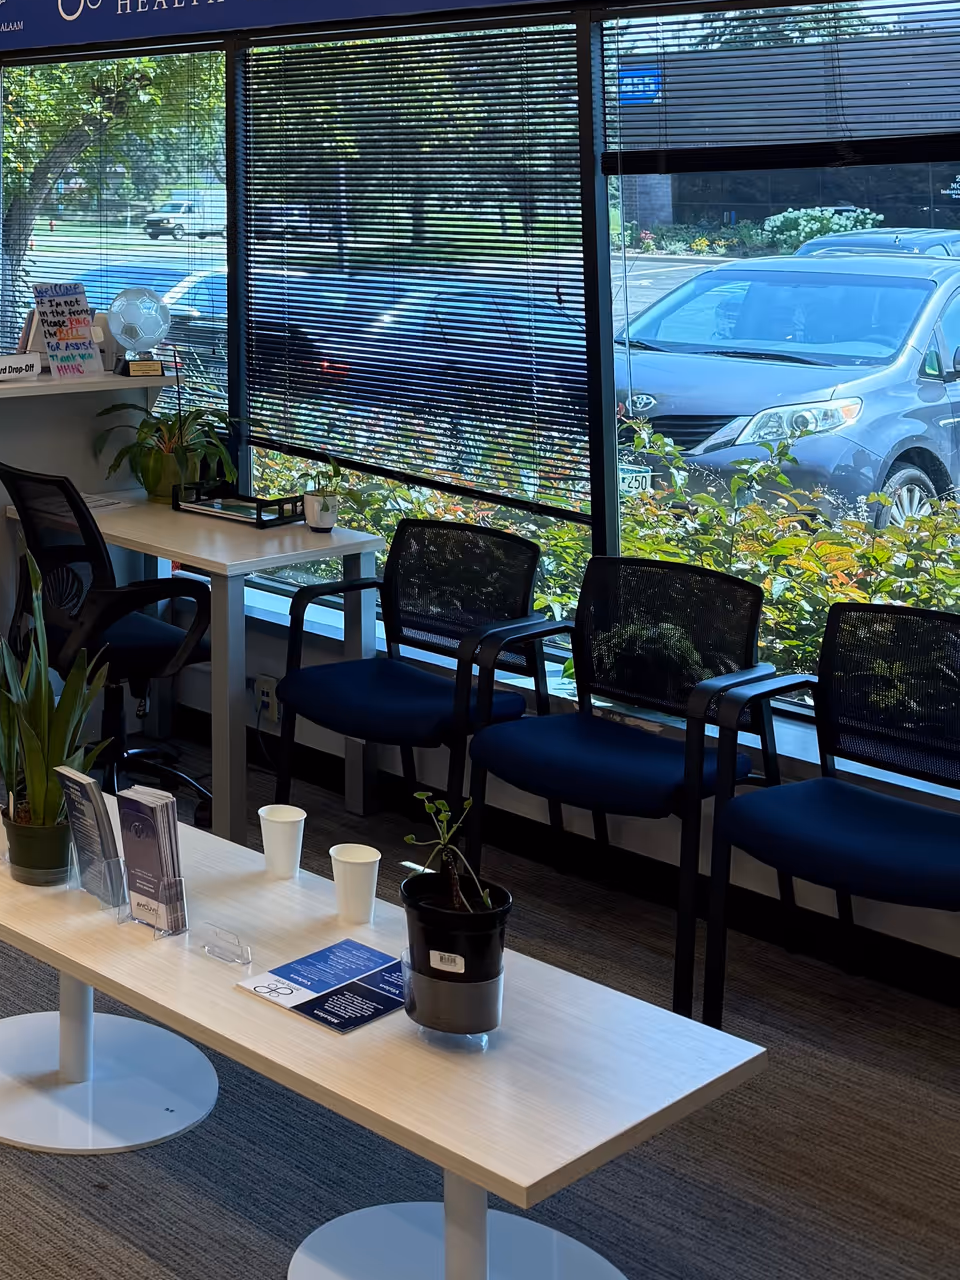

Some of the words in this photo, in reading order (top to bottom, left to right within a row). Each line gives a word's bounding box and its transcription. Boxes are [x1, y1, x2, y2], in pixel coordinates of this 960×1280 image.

[64, 297, 81, 308] not
[49, 308, 67, 318] the
[68, 307, 91, 317] front
[41, 318, 68, 328] Please
[44, 327, 57, 339] the
[8, 363, 35, 375] Drop-Off
